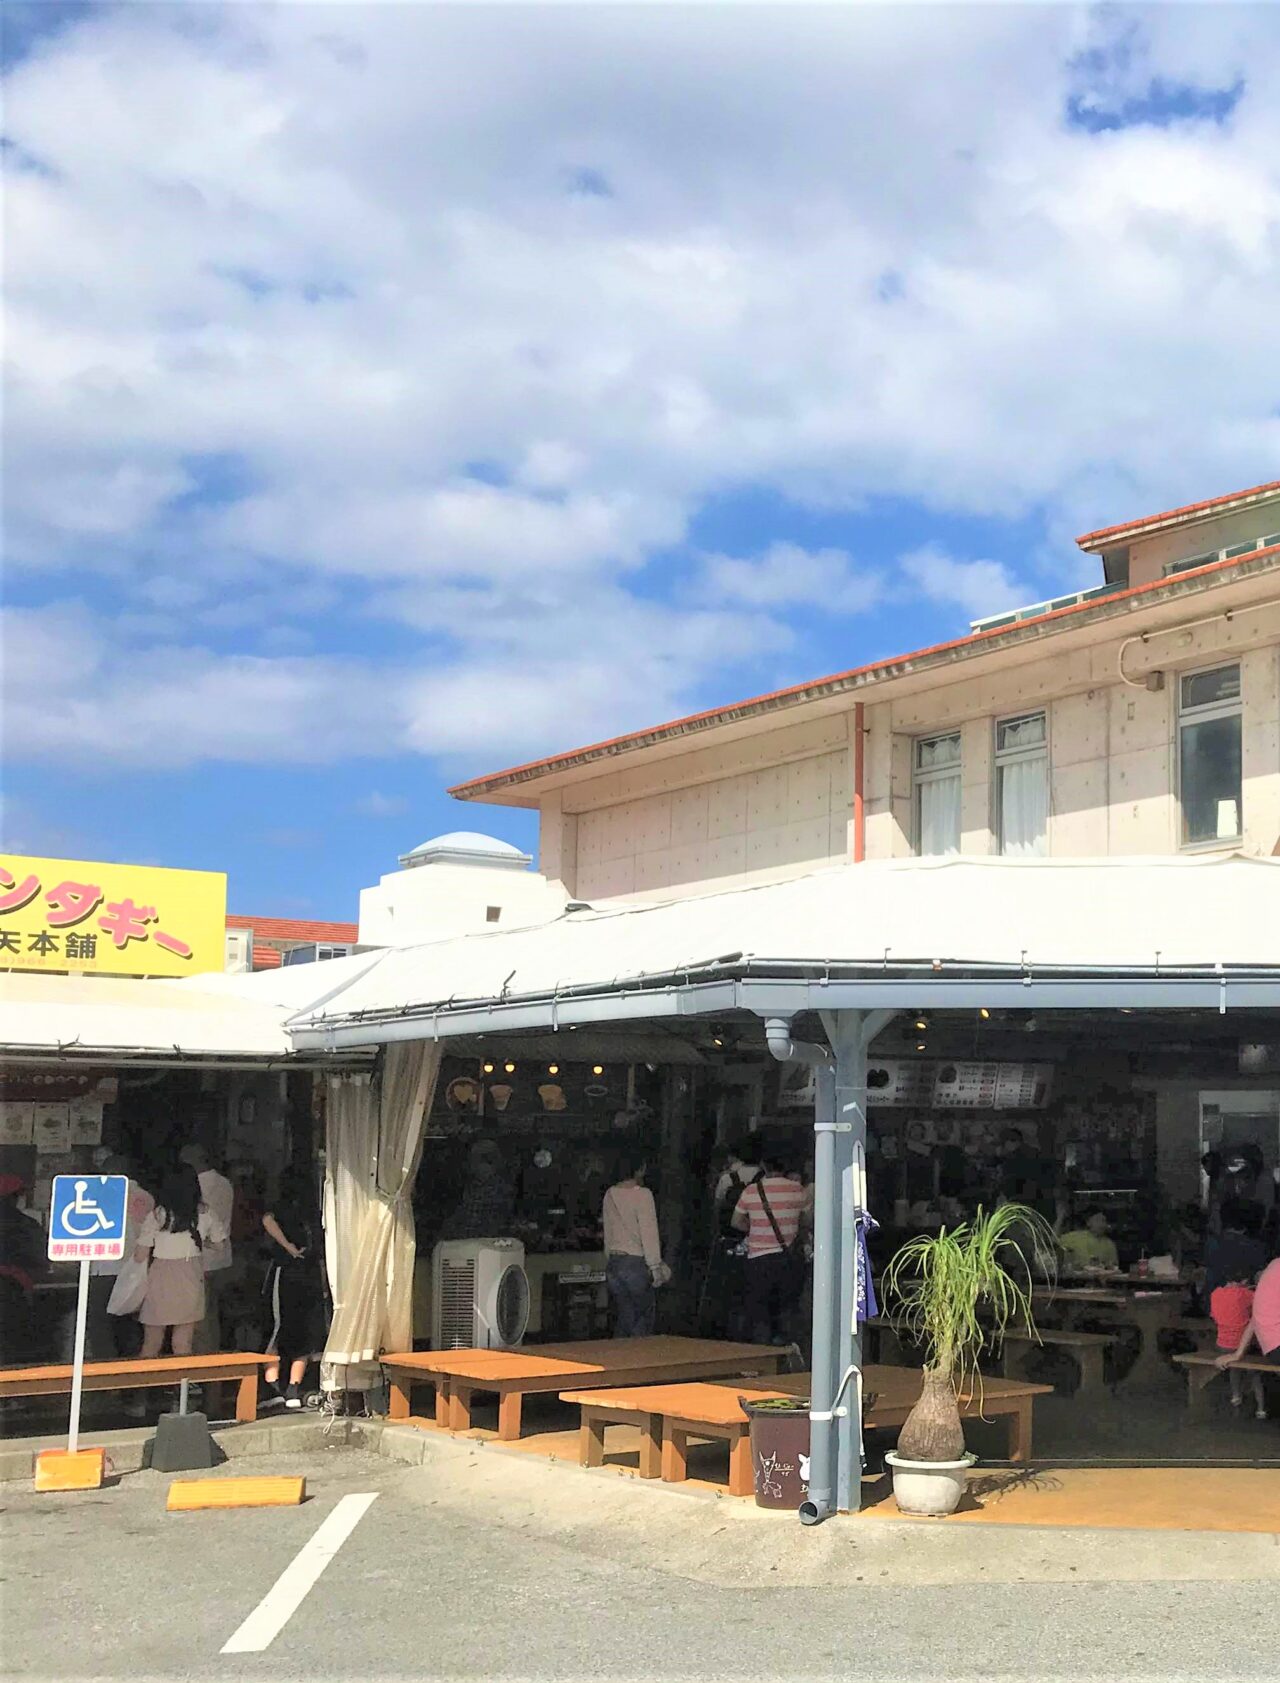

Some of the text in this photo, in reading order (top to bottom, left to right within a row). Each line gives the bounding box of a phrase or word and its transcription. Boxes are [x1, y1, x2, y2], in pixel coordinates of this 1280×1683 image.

[52, 1243, 121, 1256] 専用駐車場
